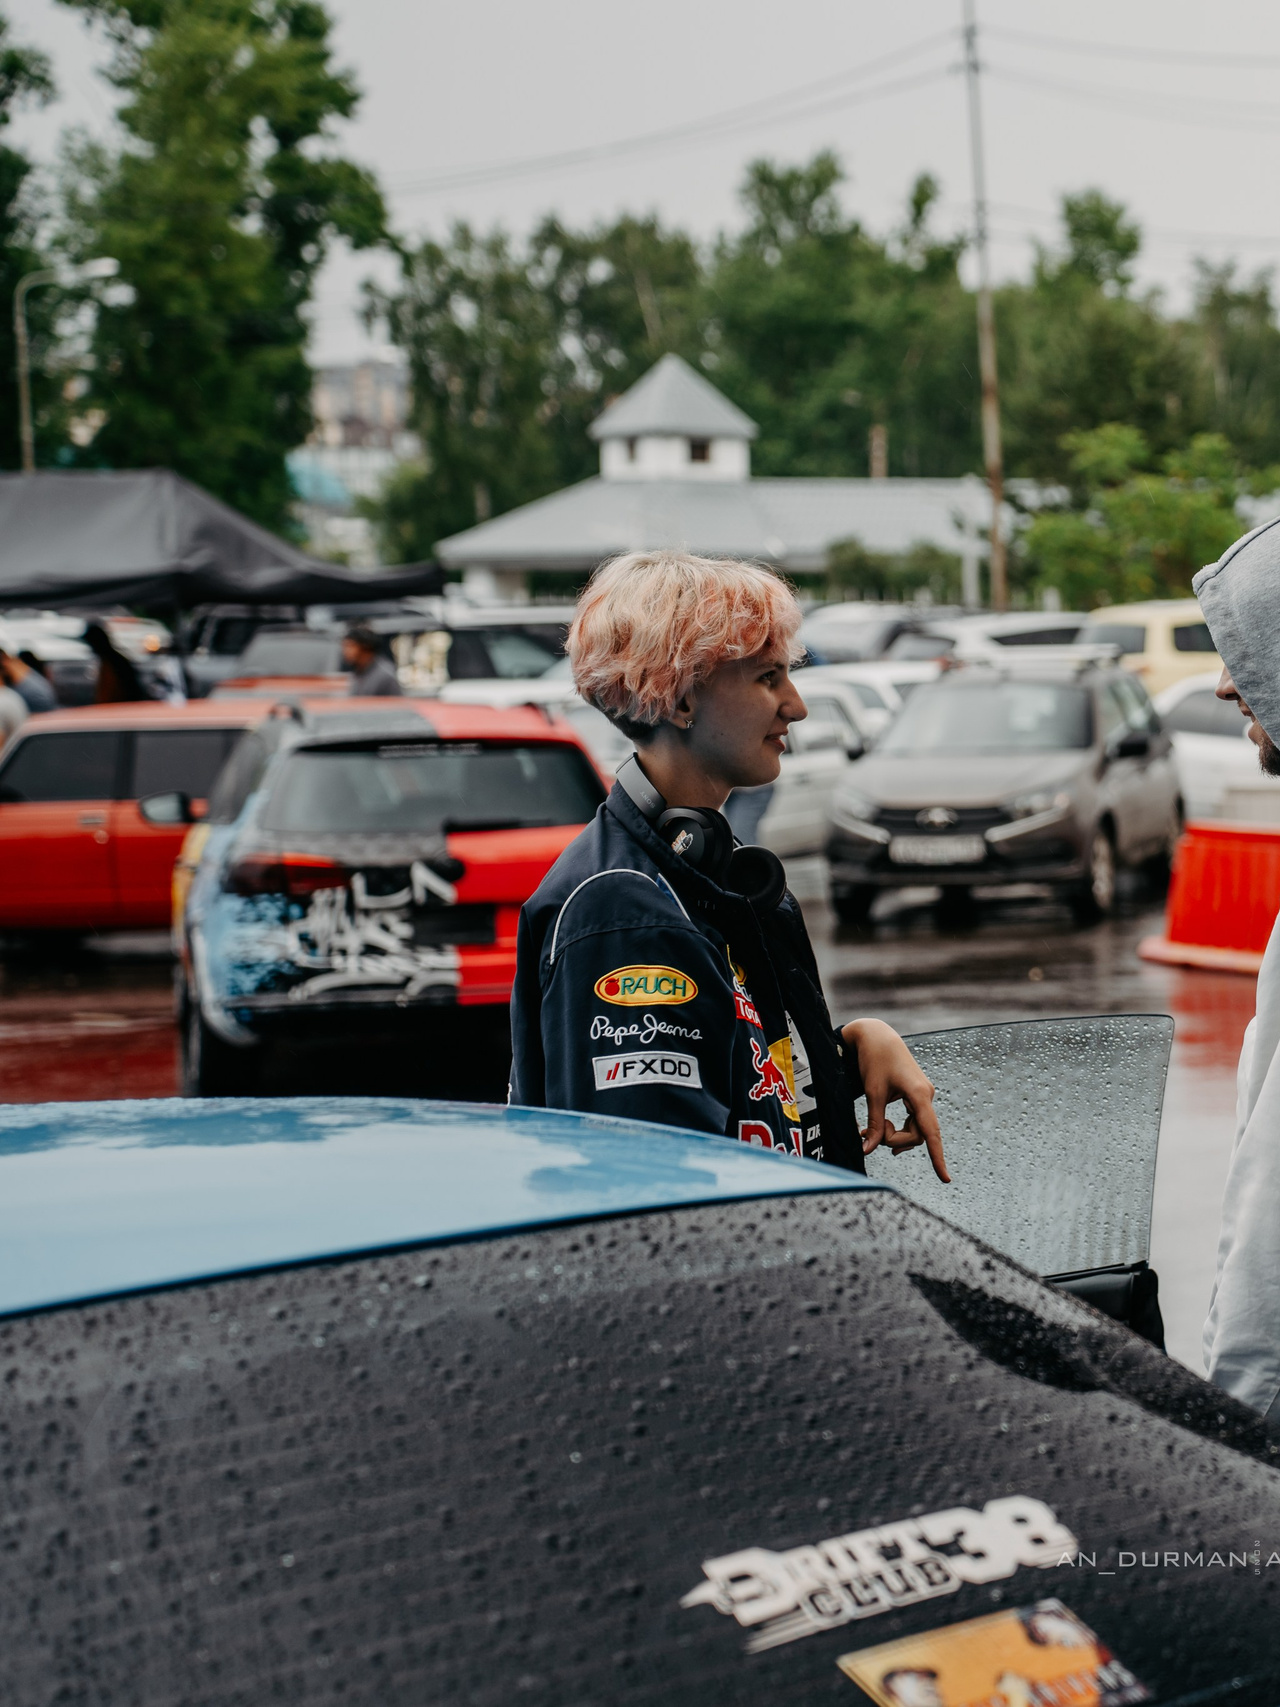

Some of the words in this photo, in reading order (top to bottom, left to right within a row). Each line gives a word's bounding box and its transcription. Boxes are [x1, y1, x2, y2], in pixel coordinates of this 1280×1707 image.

[639, 791, 656, 809] SONY
[621, 976, 687, 997] RAUCH
[590, 1015, 641, 1046] Pepe
[640, 1013, 703, 1044] Jeans
[622, 1059, 692, 1078] FXDD
[806, 1558, 954, 1620] CLUB
